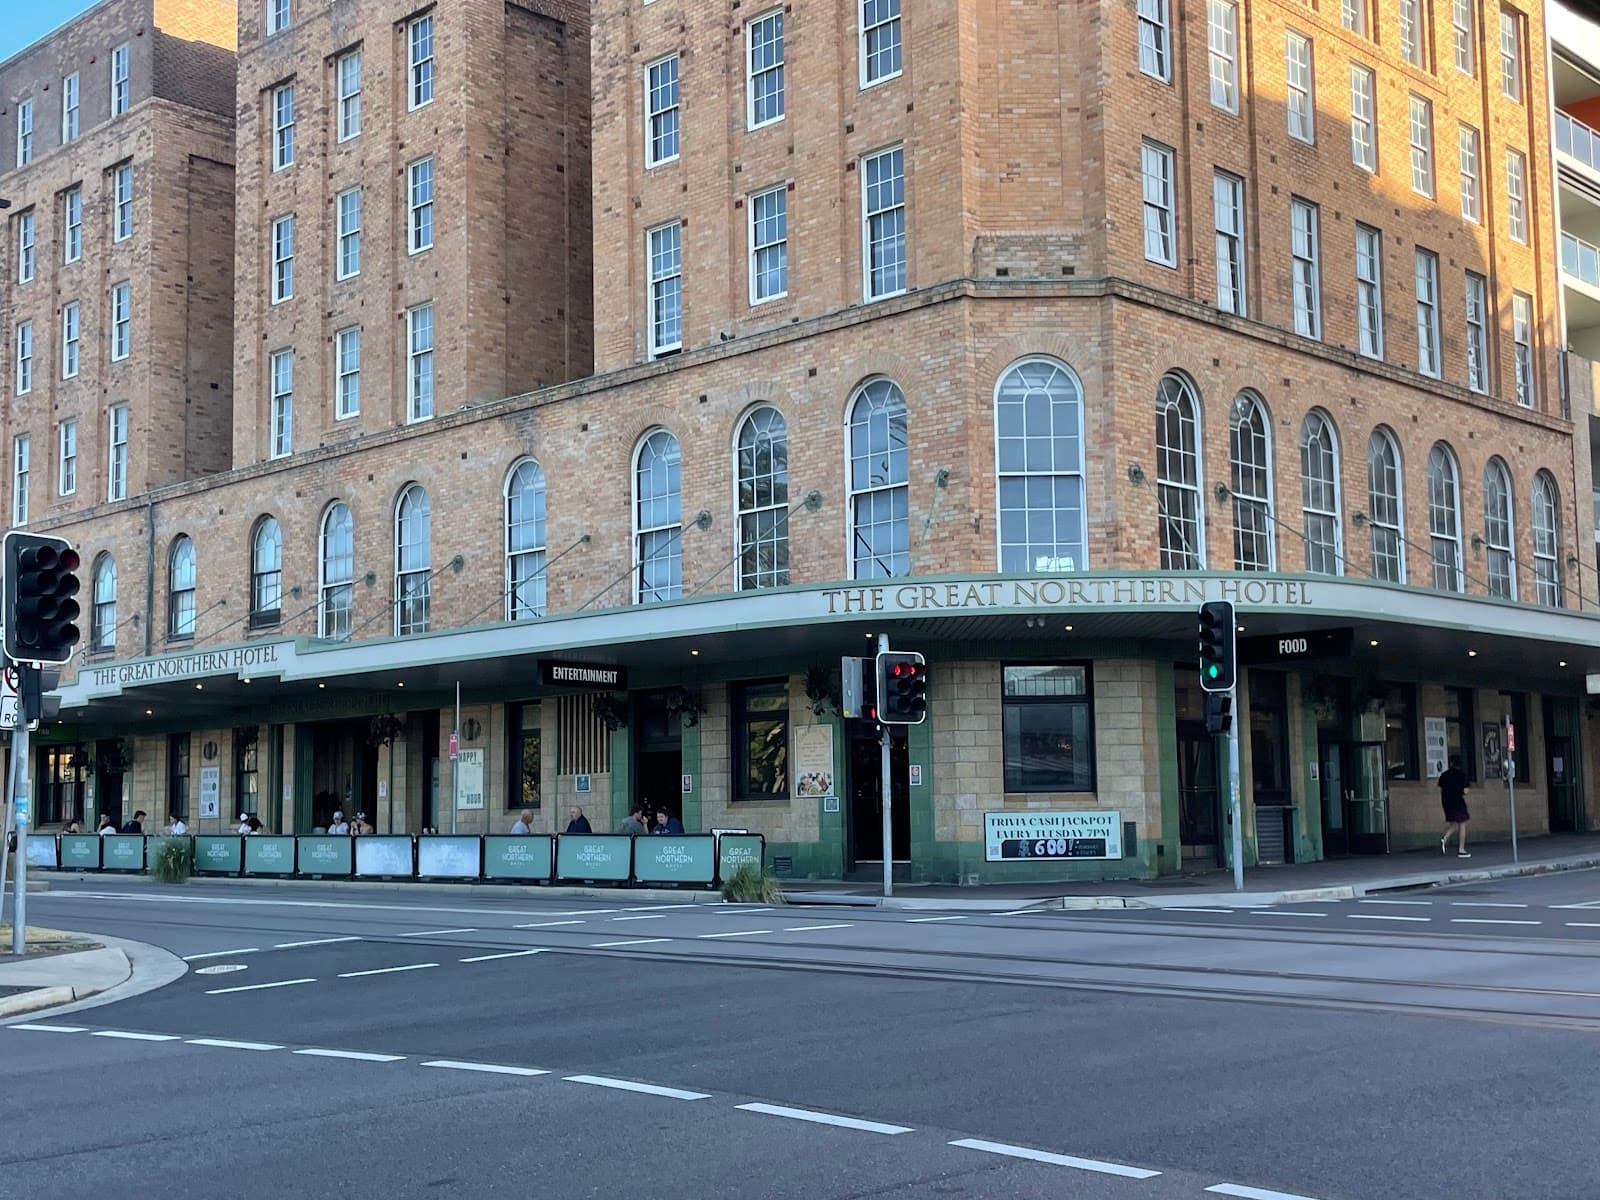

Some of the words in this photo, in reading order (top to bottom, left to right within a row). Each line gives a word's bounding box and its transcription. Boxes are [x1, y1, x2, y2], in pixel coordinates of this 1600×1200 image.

[822, 588, 884, 613] THE
[895, 583, 1003, 610] GREAT
[1013, 580, 1207, 605] NORTHERN
[1220, 580, 1312, 605] HOTEL
[1279, 638, 1307, 655] FOOD
[94, 669, 116, 686] THE
[119, 662, 156, 682] GREAT
[158, 652, 229, 677] NORTHERN
[233, 646, 278, 667] HOTEL
[552, 666, 618, 684] ENTERTAINMENT
[991, 817, 1027, 827] TRIVIA
[1029, 817, 1059, 826] CASH
[1062, 816, 1113, 827] JACKPOT
[997, 830, 1031, 839] EVERY
[1036, 829, 1086, 838] TUESDAY
[1087, 828, 1110, 837] 7PM
[584, 845, 605, 853] GREAT
[662, 846, 685, 855] GREAT
[729, 848, 752, 856] GREAT
[655, 854, 693, 864] NORTHERN
[720, 855, 760, 864] NORTHERN
